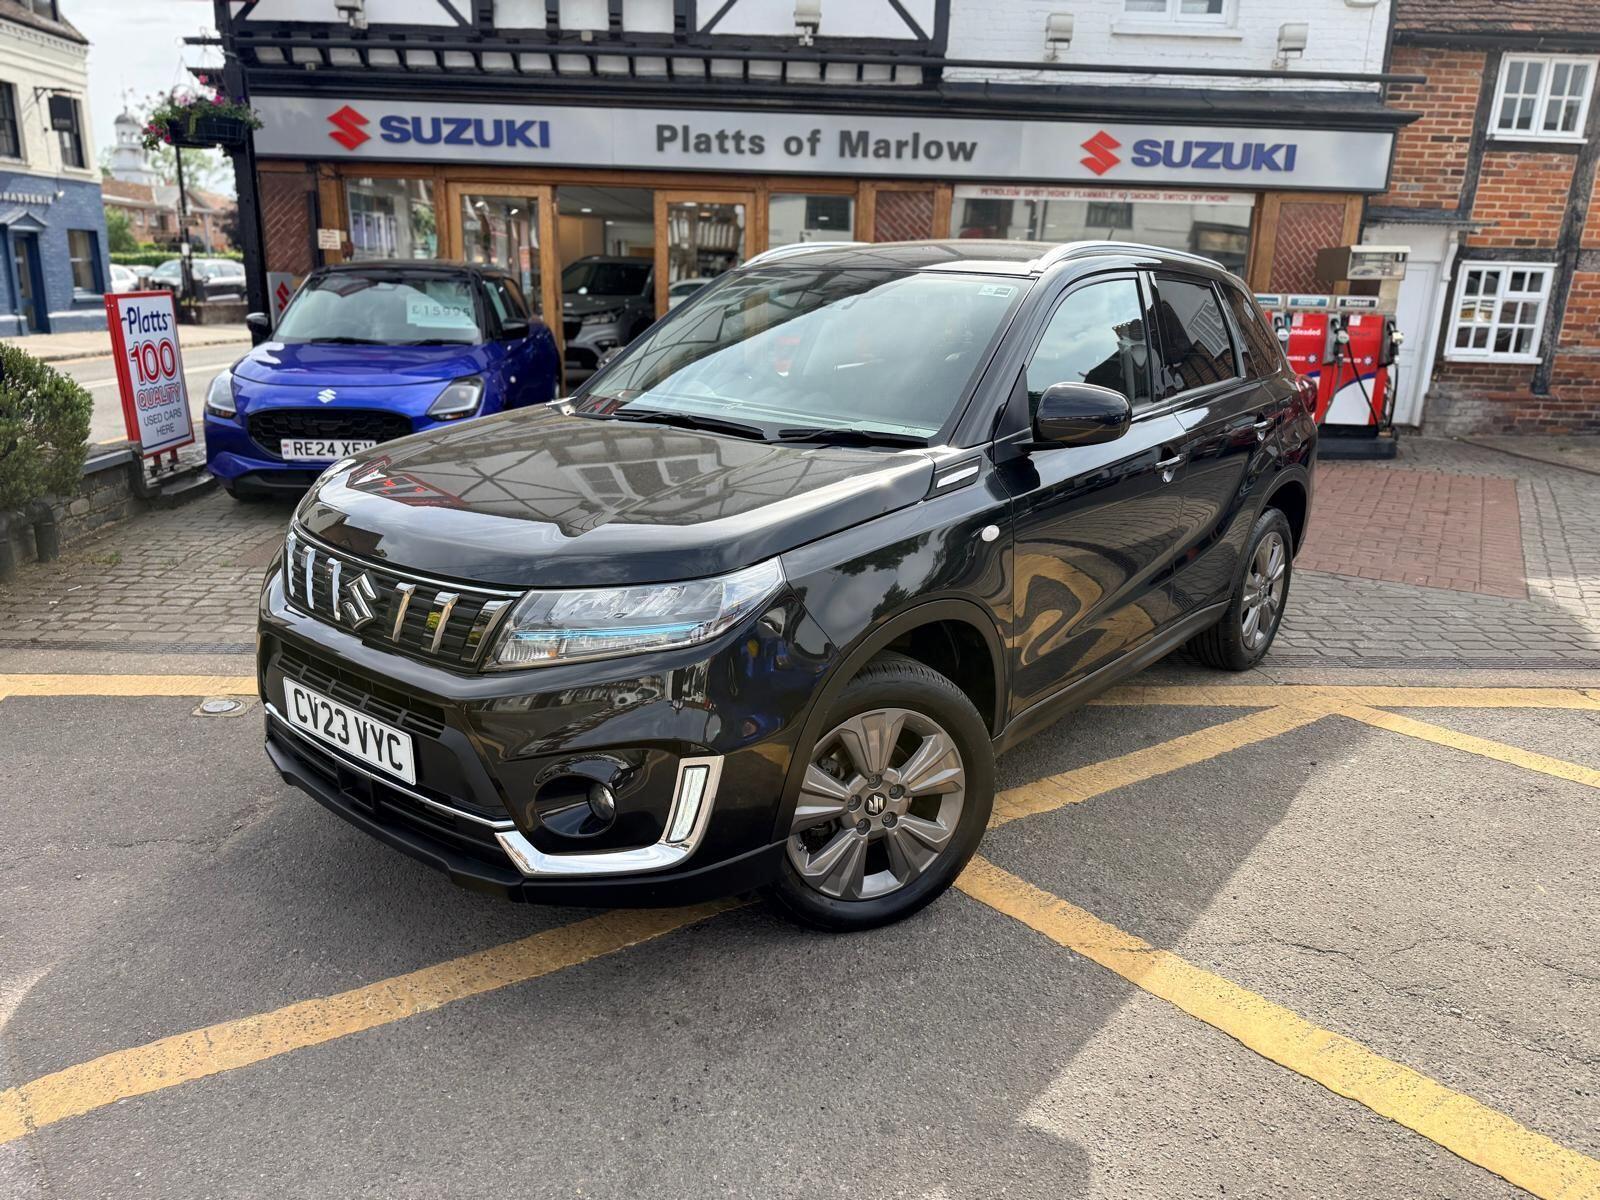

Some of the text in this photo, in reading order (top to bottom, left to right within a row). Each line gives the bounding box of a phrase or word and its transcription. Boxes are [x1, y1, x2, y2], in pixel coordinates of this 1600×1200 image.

[380, 115, 550, 149] SUZUKI
[655, 124, 978, 162] Platts of Marlow
[1131, 139, 1298, 172] SUZUKI
[0, 191, 53, 205] RASSERIE
[128, 306, 168, 334] Platts
[129, 338, 176, 385] 100
[137, 382, 181, 411] QUALITY
[143, 408, 182, 427] USED CARS
[156, 423, 175, 437] HERE
[293, 441, 336, 456] RE24
[293, 687, 403, 772] CV23 VYC
